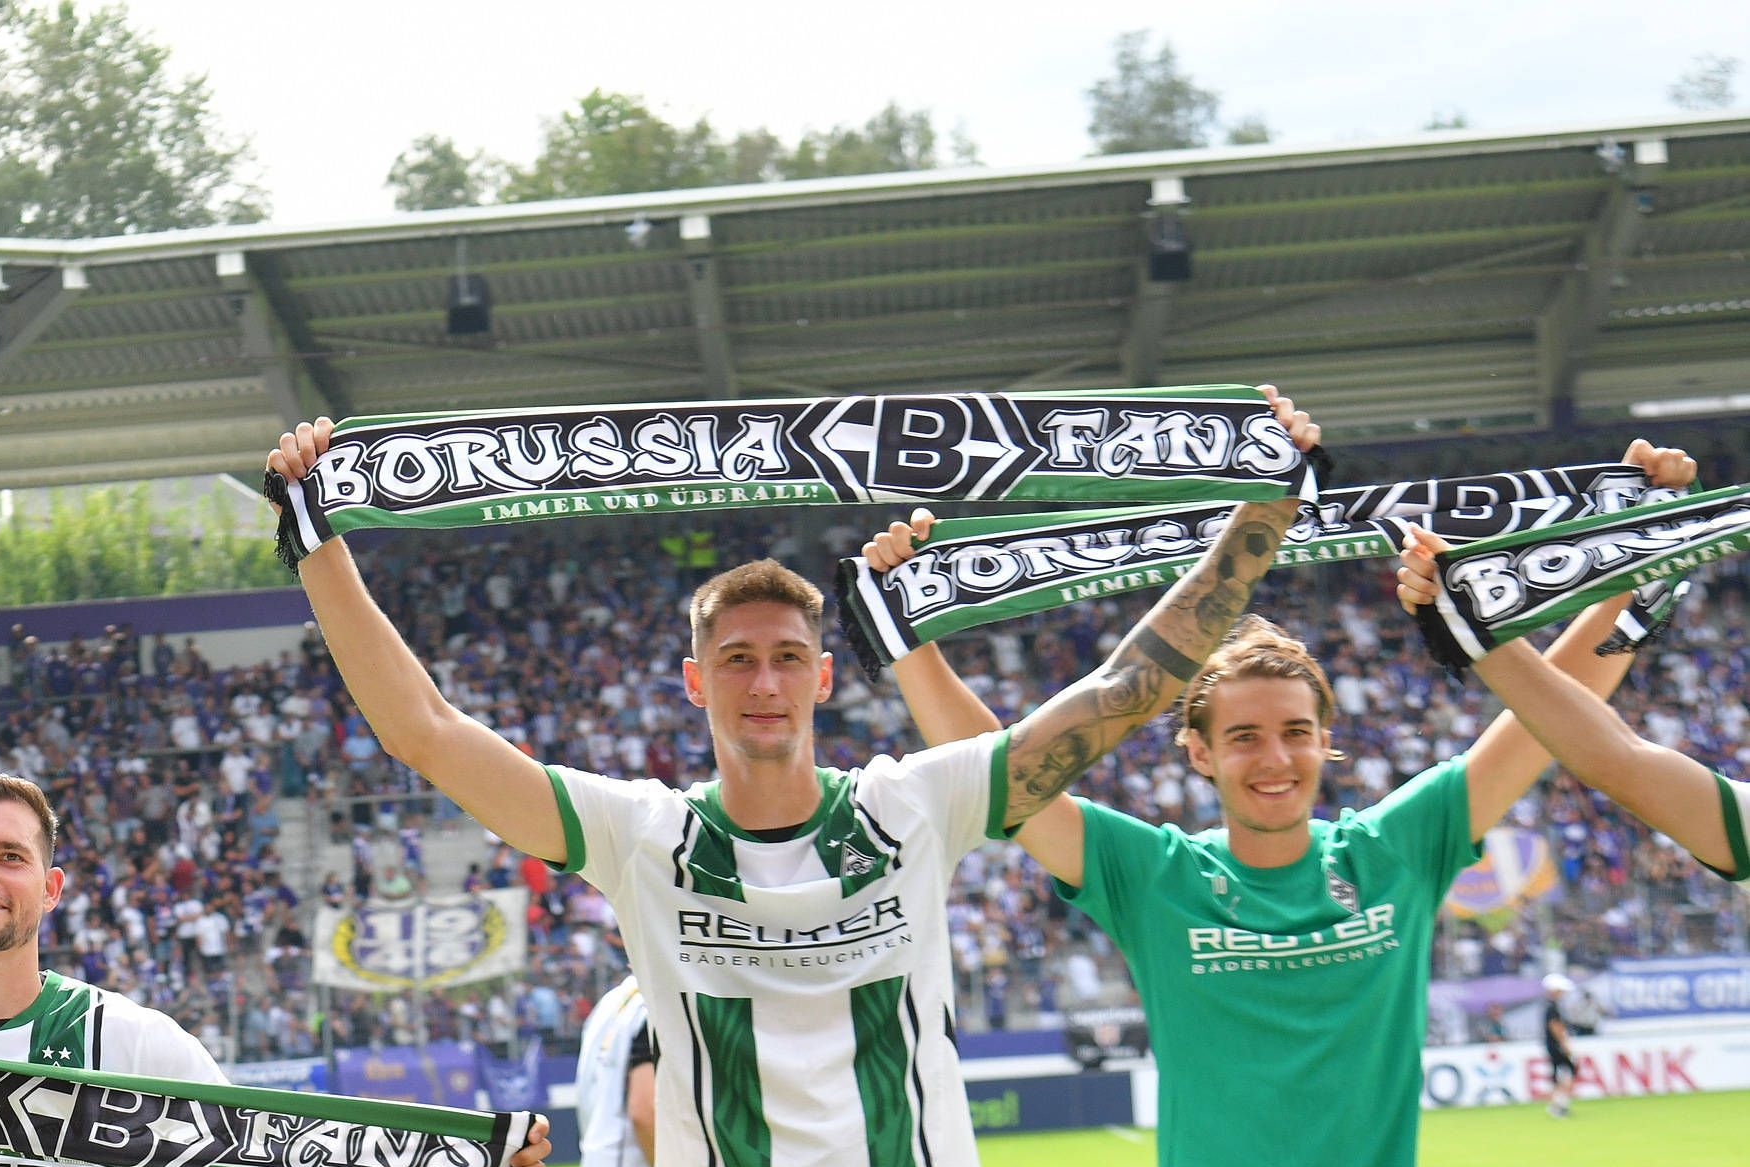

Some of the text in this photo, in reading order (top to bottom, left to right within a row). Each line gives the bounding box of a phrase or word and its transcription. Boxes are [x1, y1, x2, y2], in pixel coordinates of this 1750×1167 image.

[307, 413, 791, 508] BORUSSIA
[1038, 406, 1303, 479] FANS
[481, 484, 821, 522] IMMER UND ÜBERALL!
[1060, 568, 1165, 602] IMMER
[678, 895, 905, 944] REUTER
[678, 933, 914, 968] BÄDER LEUCHTEN
